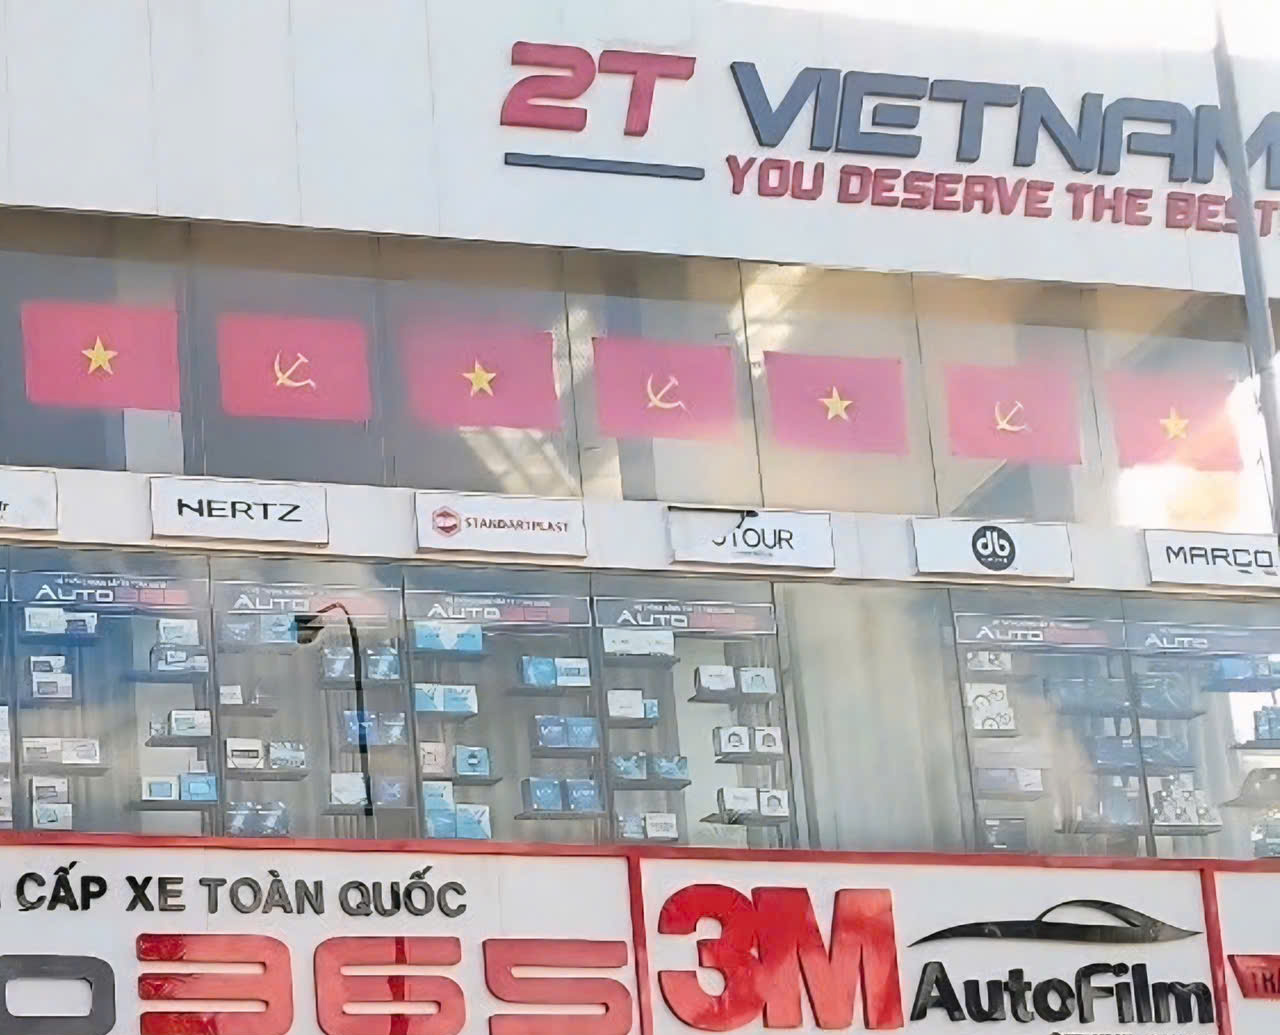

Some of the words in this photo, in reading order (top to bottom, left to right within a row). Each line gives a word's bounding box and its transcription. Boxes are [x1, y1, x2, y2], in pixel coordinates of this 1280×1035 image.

[501, 41, 696, 136] 2T
[730, 62, 1280, 190] VIETNAM
[726, 154, 824, 200] YOU
[838, 165, 1054, 218] DESERVE
[1066, 182, 1153, 227] THE
[177, 498, 303, 523] HERTZ
[15, 858, 108, 912] CẤP
[124, 875, 187, 913] XE
[198, 869, 325, 916] TOÀN
[338, 863, 467, 919] QUỐC
[656, 883, 905, 1033] 3M
[909, 961, 1215, 1025] AutoFilm
